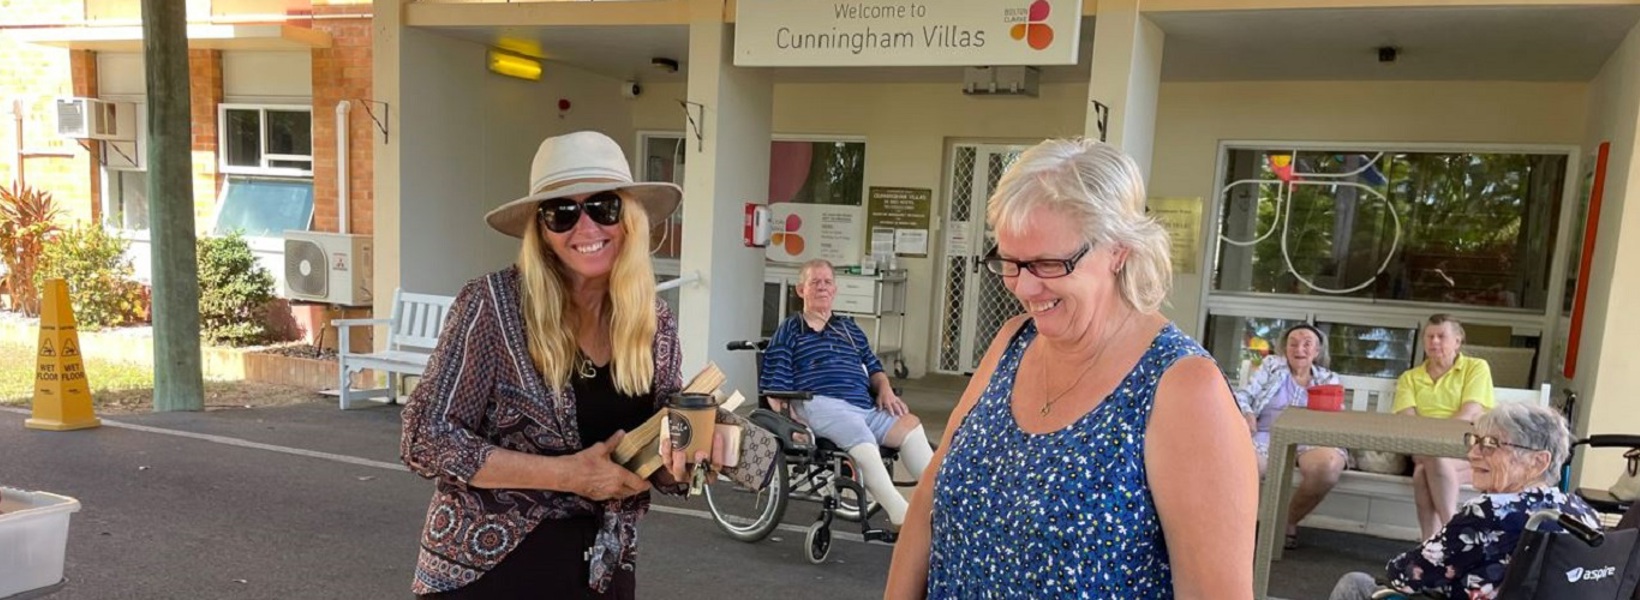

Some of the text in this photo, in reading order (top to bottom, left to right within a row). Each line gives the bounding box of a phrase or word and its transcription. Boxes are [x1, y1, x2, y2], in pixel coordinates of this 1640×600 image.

[835, 2, 926, 19] Welcome to
[776, 25, 985, 54] Cunningham Villas
[40, 364, 55, 372] WET
[63, 363, 79, 372] WET
[36, 372, 58, 381] FLOOR
[61, 371, 85, 381] FLOOR
[1583, 565, 1616, 581] aspire
